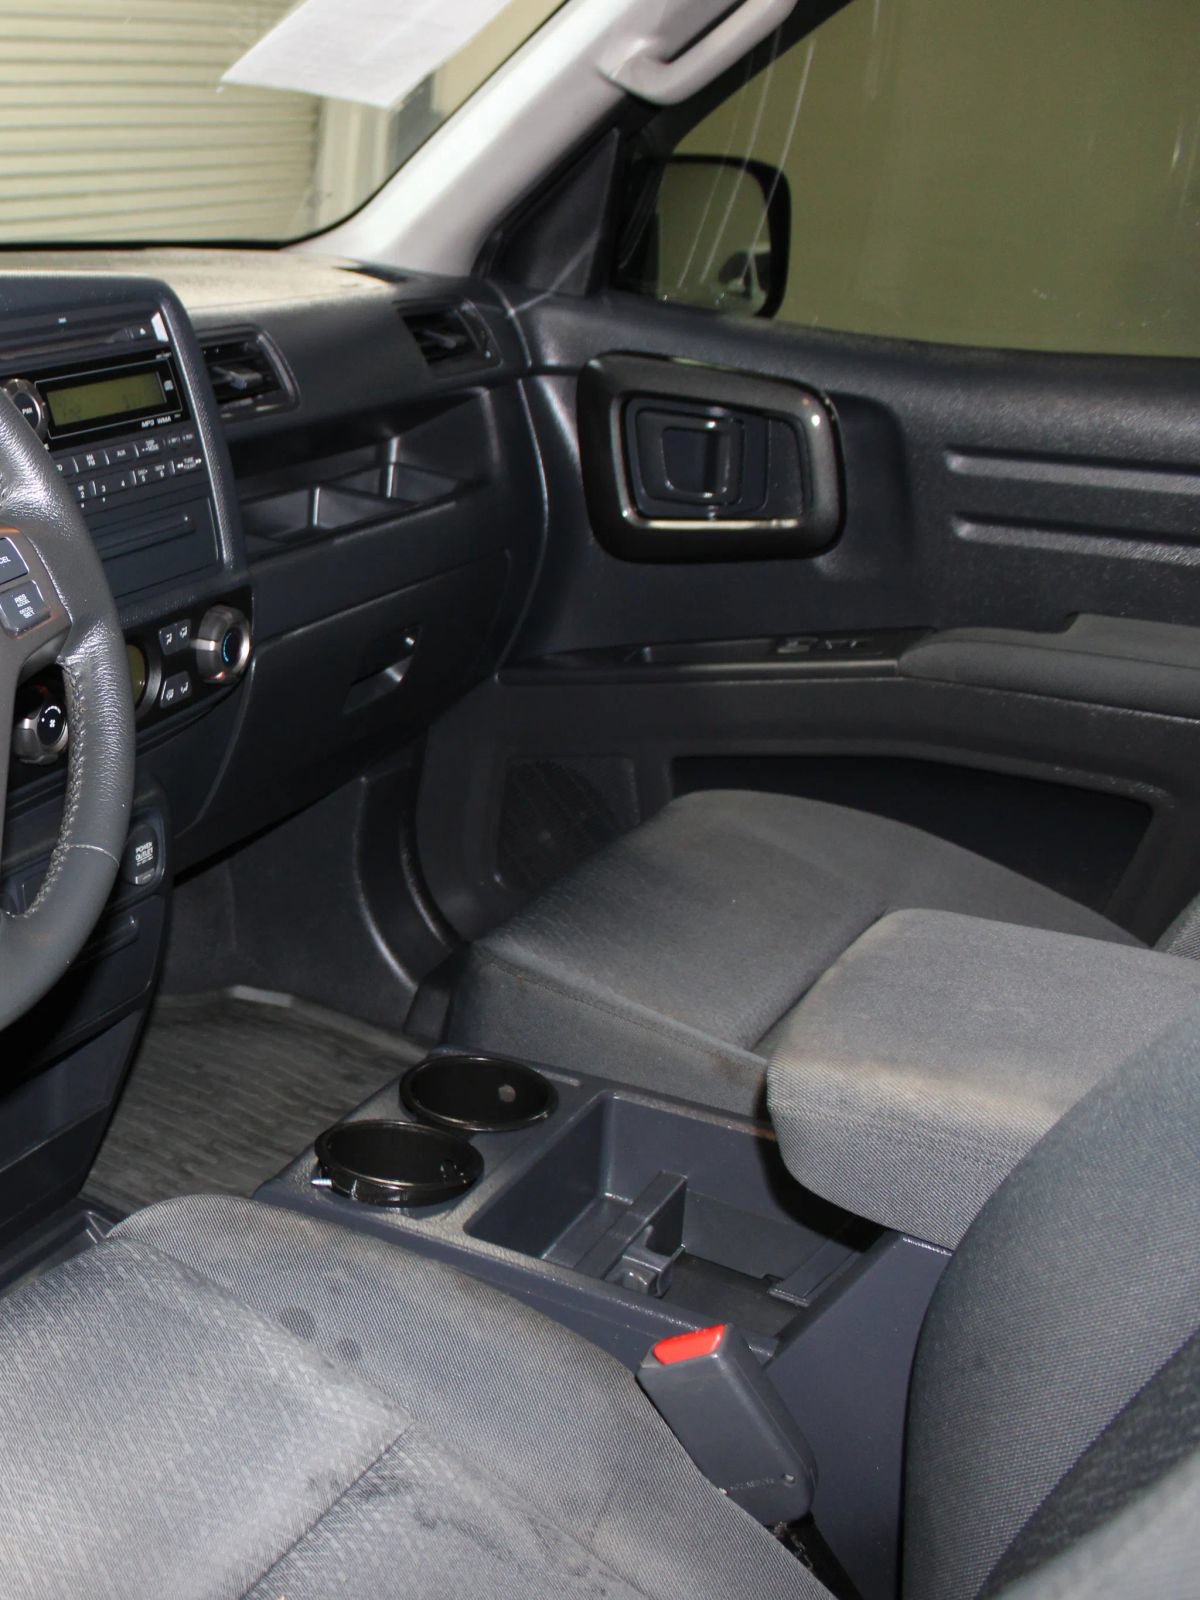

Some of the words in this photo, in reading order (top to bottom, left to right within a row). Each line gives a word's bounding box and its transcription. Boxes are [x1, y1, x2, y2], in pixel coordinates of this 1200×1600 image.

[157, 415, 172, 425] WMA
[14, 593, 27, 603] RES
[23, 610, 35, 619] SET
[135, 841, 153, 854] POWER
[135, 847, 154, 861] OUTLET
